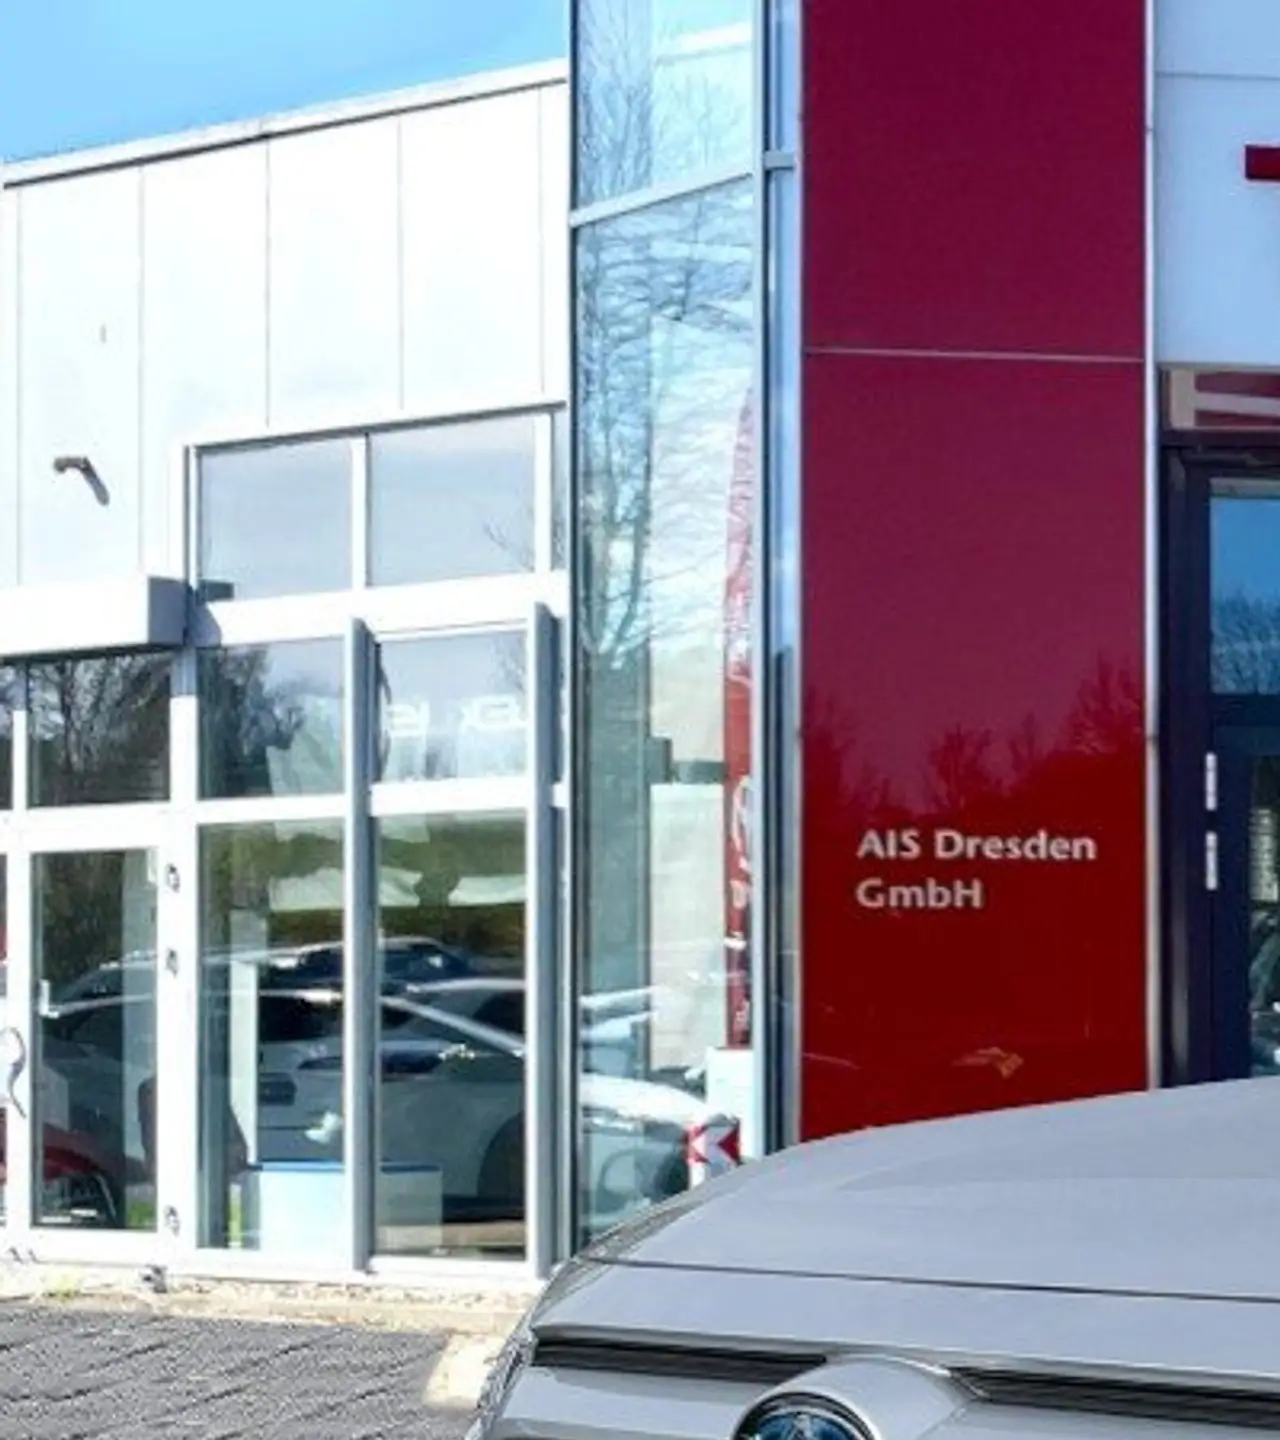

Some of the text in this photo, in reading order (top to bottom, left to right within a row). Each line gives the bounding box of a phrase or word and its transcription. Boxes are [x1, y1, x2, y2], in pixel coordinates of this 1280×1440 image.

[856, 829, 1096, 860] AIS Dresden
[856, 877, 983, 908] GmbH
